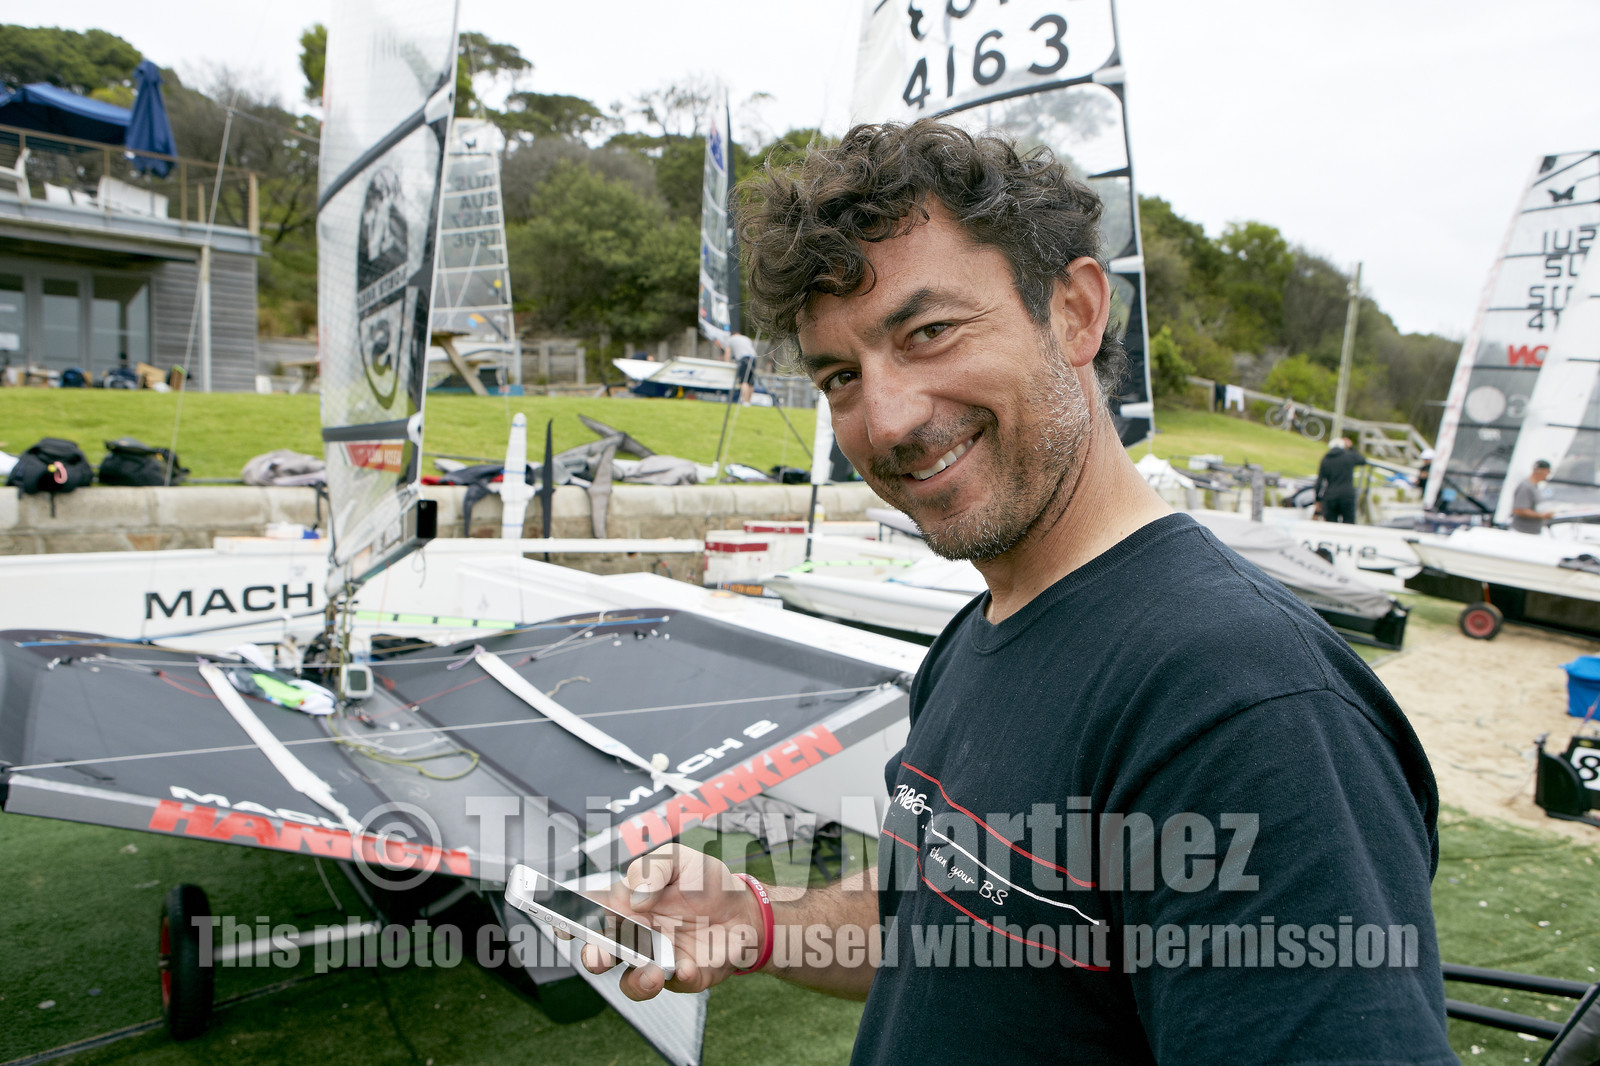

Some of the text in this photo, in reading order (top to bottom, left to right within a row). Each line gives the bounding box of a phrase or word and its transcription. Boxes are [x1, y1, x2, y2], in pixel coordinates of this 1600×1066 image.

[903, 14, 1068, 110] 4163
[145, 583, 313, 619] MACH
[606, 720, 779, 814] MACH 2
[618, 724, 844, 857] HARKEN
[149, 799, 471, 876] HARKEN
[929, 846, 1009, 906] than your BS
